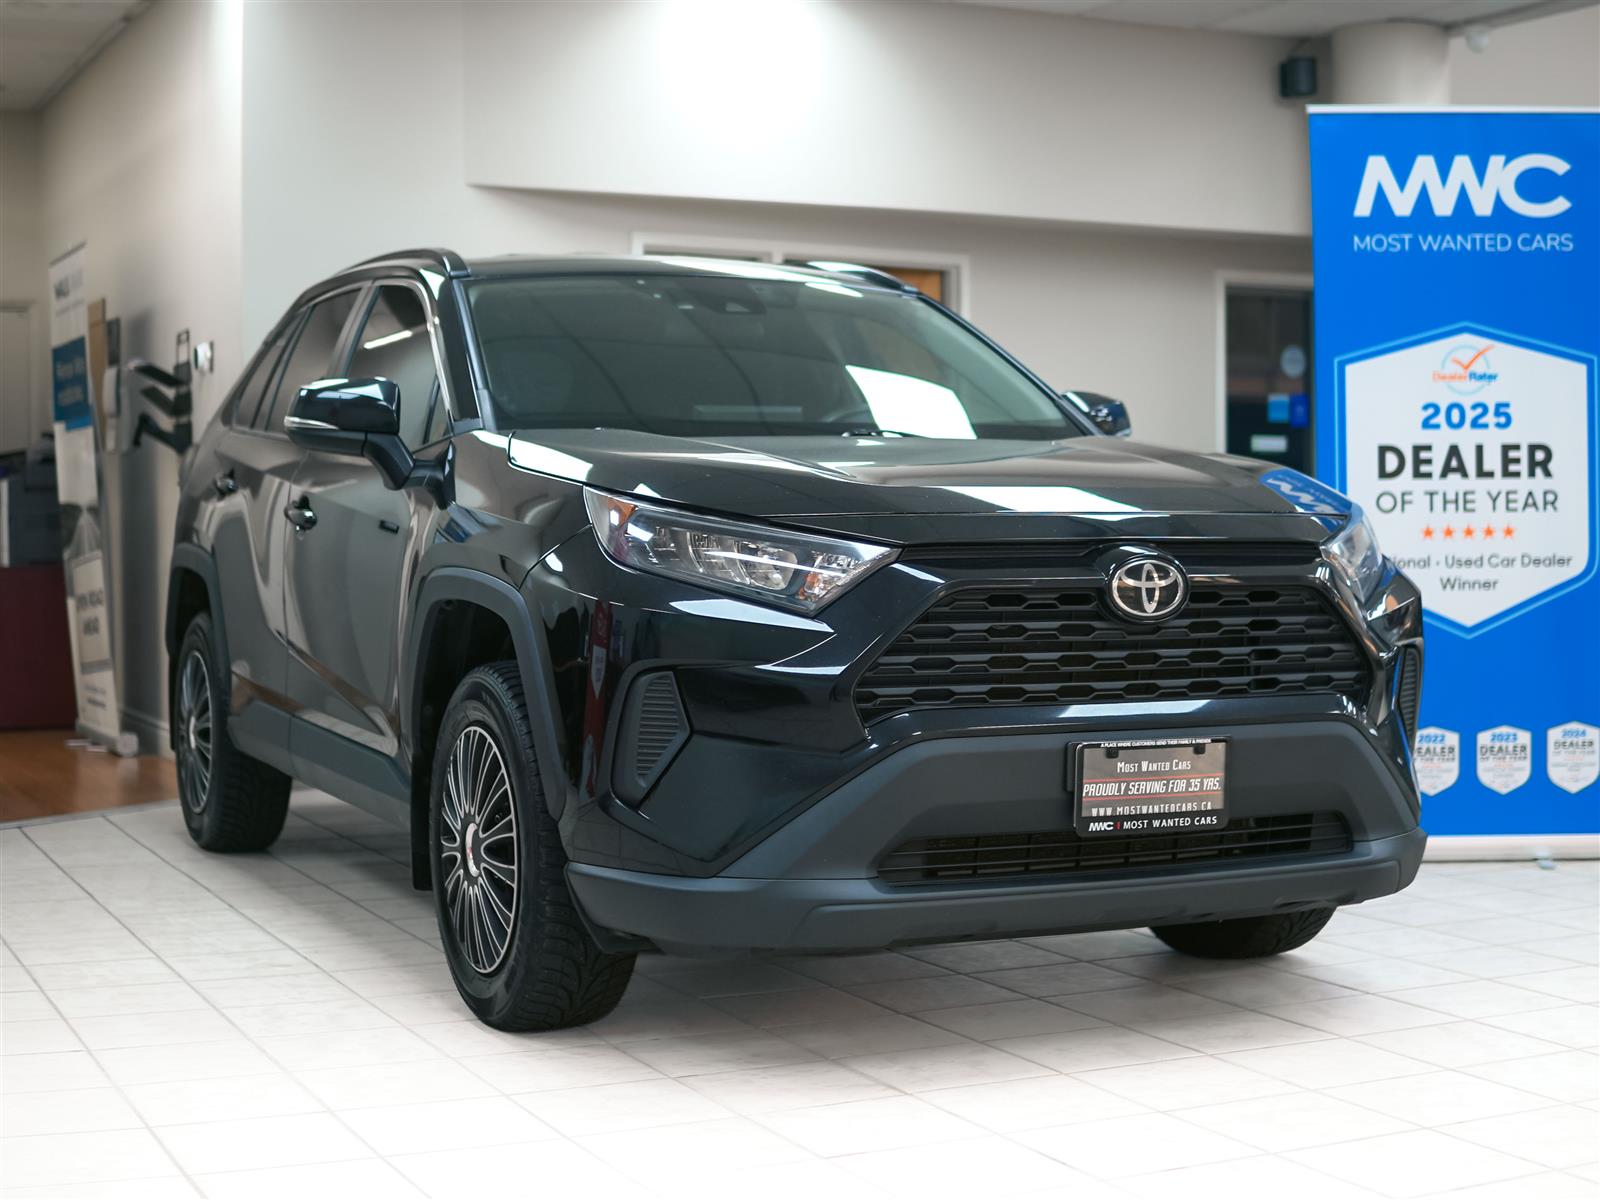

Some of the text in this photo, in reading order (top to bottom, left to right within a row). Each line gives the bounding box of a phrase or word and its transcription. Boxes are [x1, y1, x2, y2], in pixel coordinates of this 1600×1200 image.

[1353, 153, 1573, 218] MWC
[1353, 233, 1573, 252] MOST WANTED CARS
[1421, 402, 1512, 430] 2025
[1377, 444, 1553, 479] DEALER
[1376, 490, 1559, 514] OF THE YEAR
[1392, 553, 1573, 569] ional Used Car Dealer
[1440, 576, 1499, 591] Winner
[1418, 733, 1446, 744] 2022
[1553, 740, 1594, 750] DEALER
[1416, 745, 1455, 757] EALER
[1480, 744, 1527, 757] DEALER
[1083, 777, 1222, 797] PROUDLY SERVING FOR 35 YRS.
[1088, 816, 1217, 832] MWC MOST WANTED CARS
